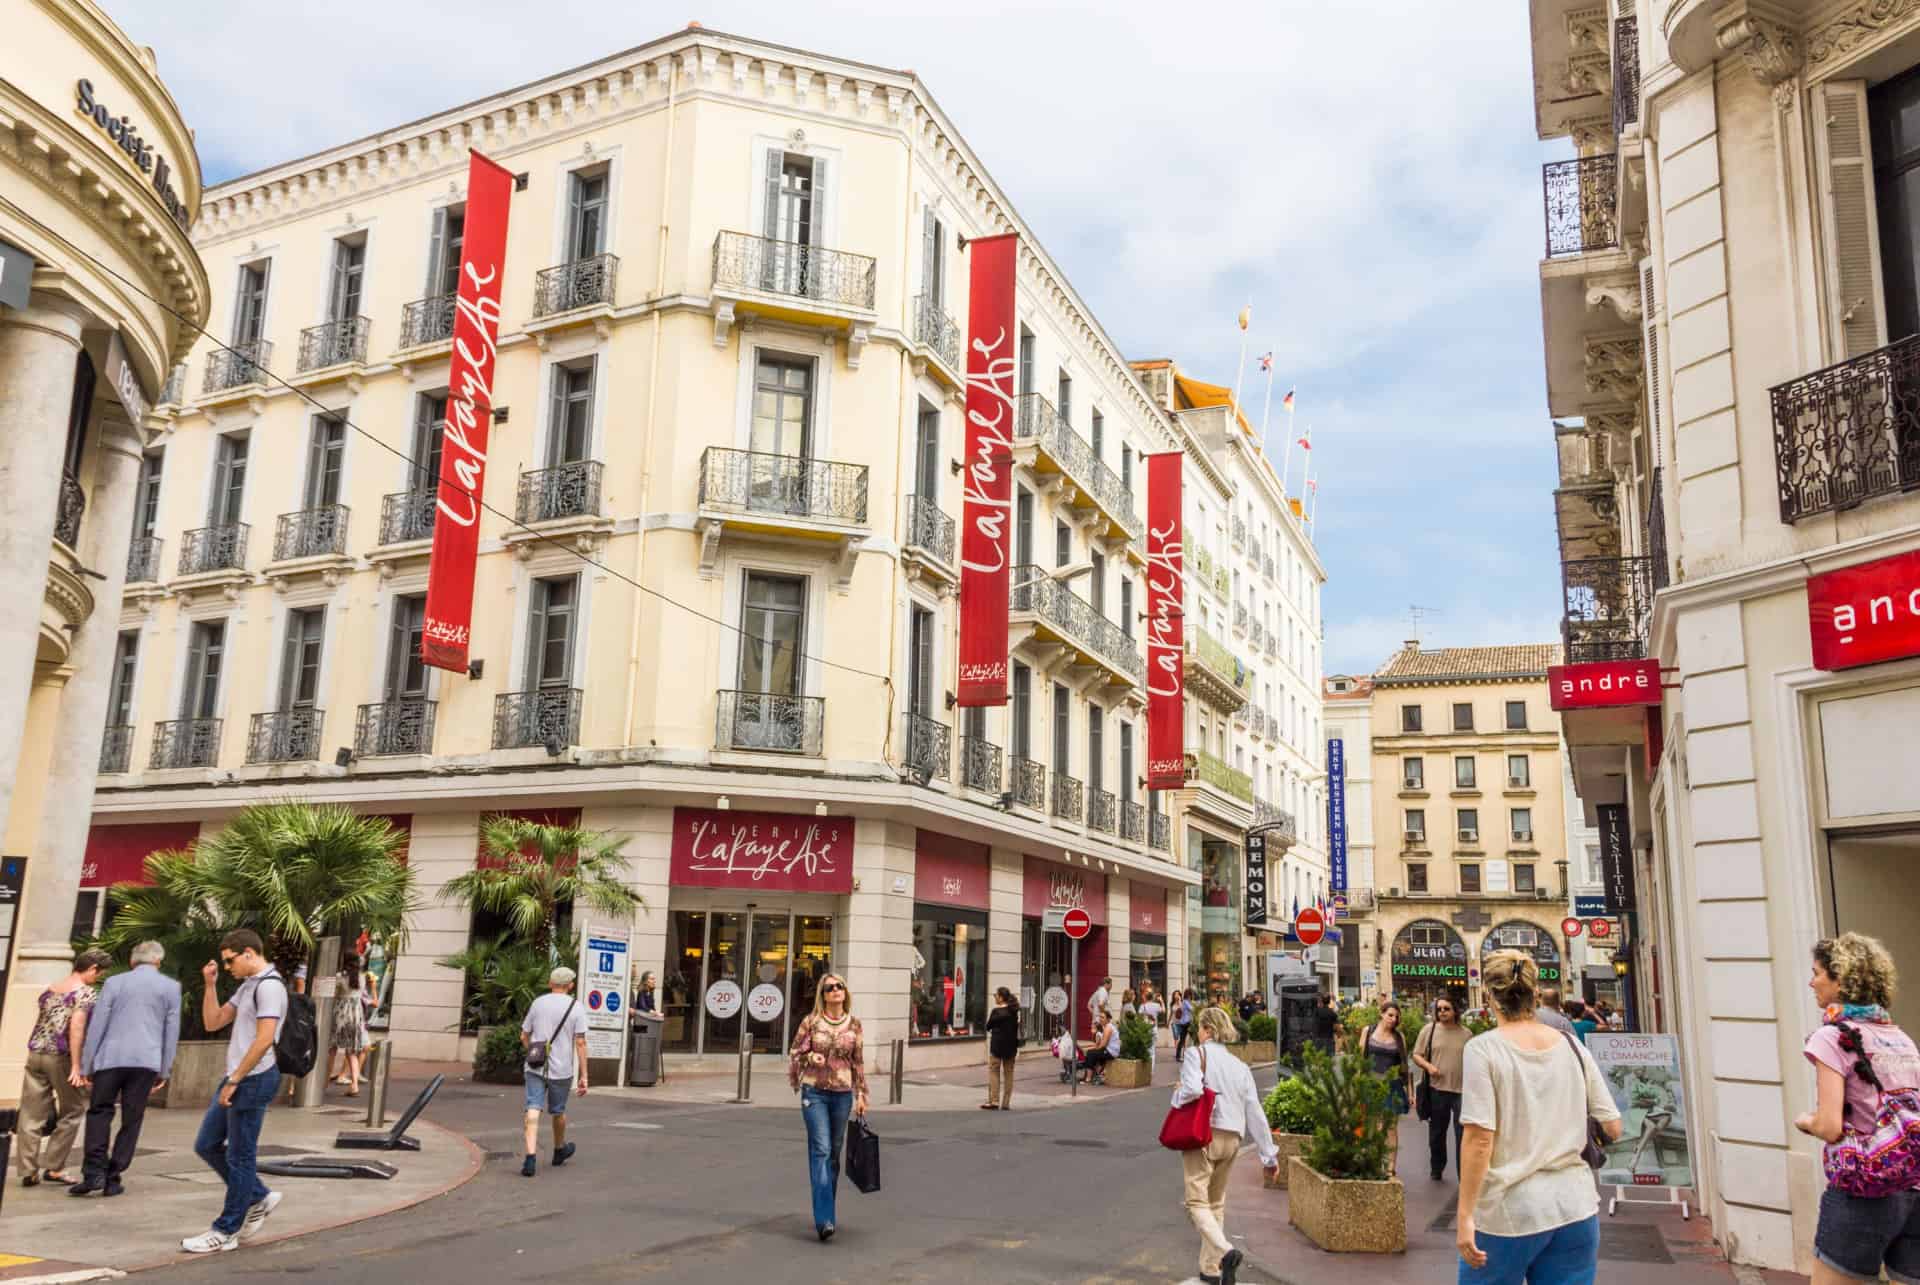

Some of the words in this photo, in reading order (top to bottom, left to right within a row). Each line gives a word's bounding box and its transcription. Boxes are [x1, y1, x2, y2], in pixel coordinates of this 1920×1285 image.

[1560, 669, 1649, 699] andré
[1332, 740, 1340, 771] BEST
[1332, 775, 1341, 829] WESTERN
[691, 821, 839, 842] GALERIES
[688, 820, 836, 881] Lafayette
[1247, 837, 1265, 908] BEMON
[1393, 964, 1466, 977] PHARMACIE
[1598, 1051, 1609, 1061] LE
[1611, 1050, 1669, 1062] DIMANCHE
[1609, 1039, 1653, 1049] OUVERT
